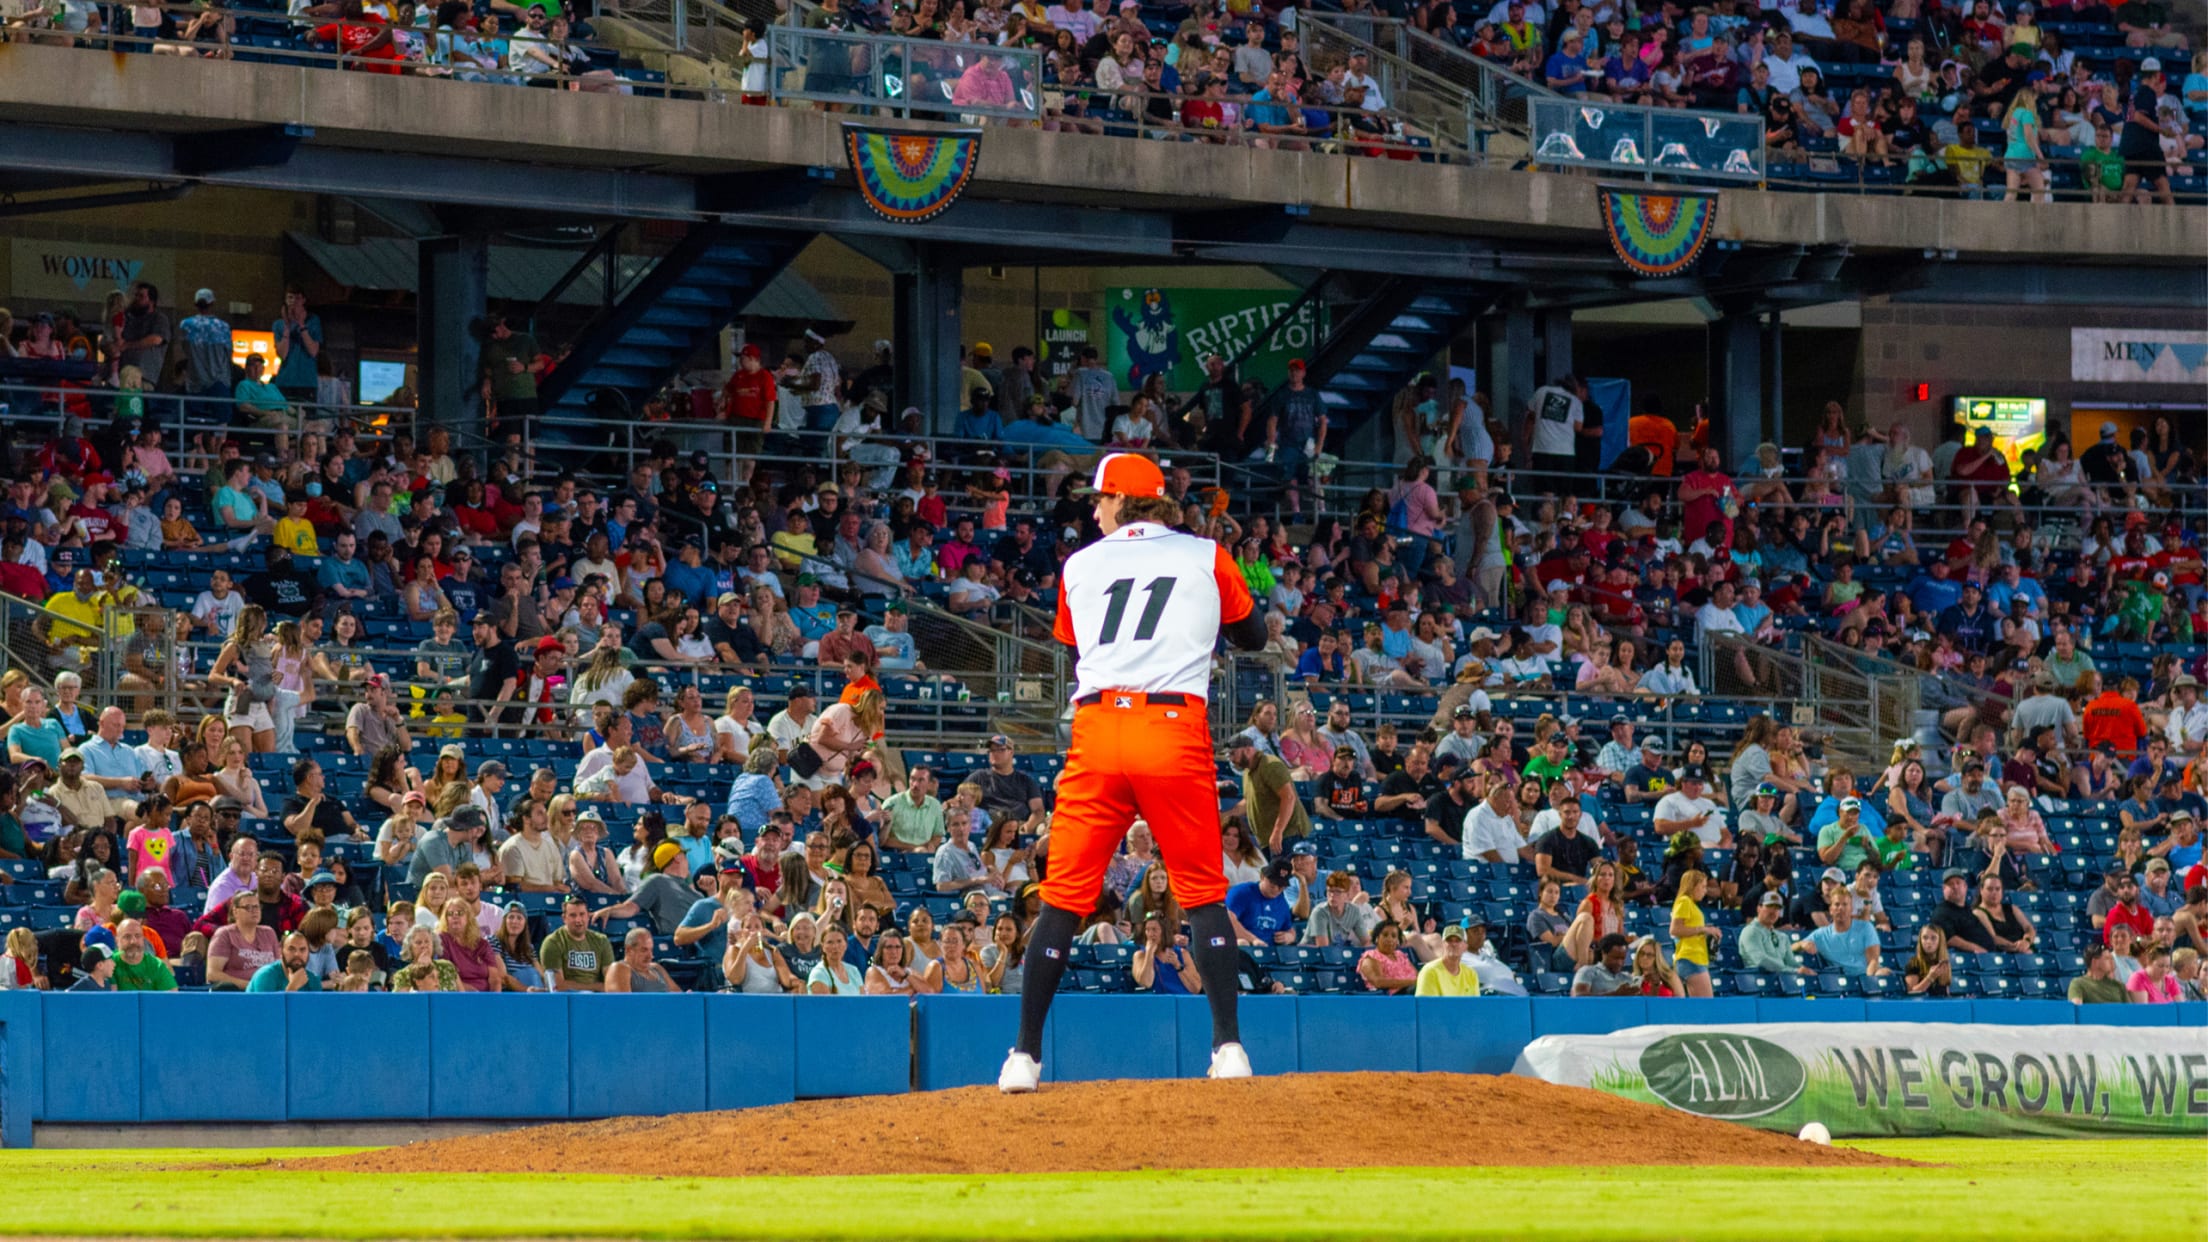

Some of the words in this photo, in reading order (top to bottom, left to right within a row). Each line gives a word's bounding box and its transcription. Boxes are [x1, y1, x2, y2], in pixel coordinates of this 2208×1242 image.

[42, 254, 131, 281] WOMEN
[1045, 328, 1087, 342] LAUNCH
[2104, 341, 2157, 361] MEN
[1052, 361, 1071, 375] BA
[1098, 576, 1178, 646] 11
[1681, 1039, 1770, 1102] ALM
[1832, 1047, 1931, 1110] WE
[1939, 1047, 2111, 1121] GROW,
[2126, 1053, 2208, 1117] WE
